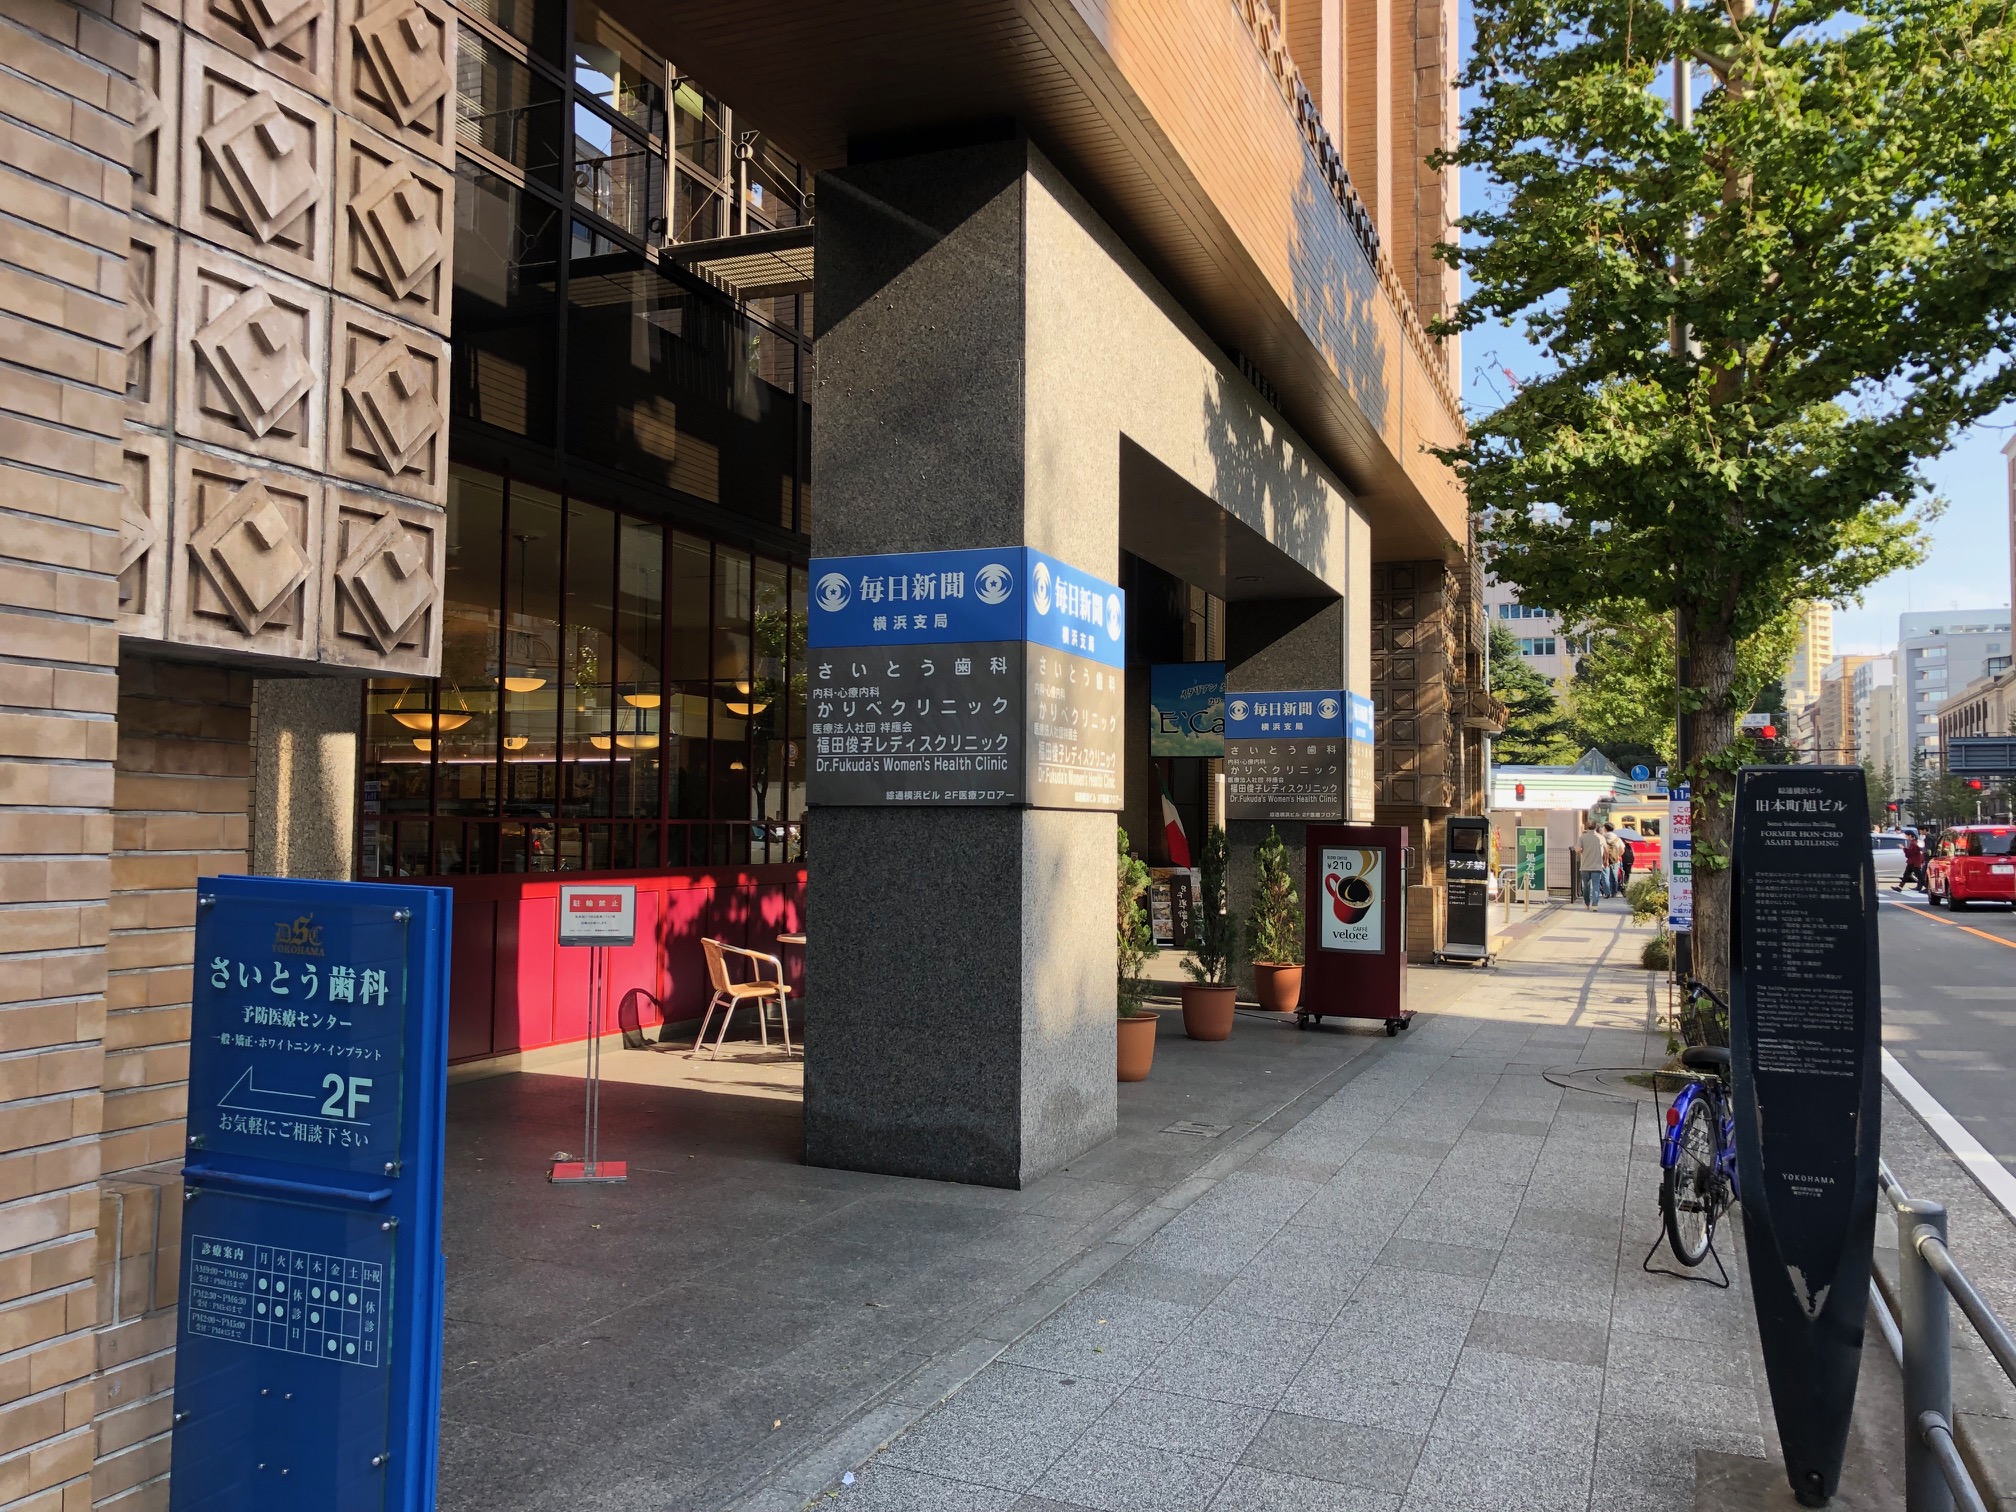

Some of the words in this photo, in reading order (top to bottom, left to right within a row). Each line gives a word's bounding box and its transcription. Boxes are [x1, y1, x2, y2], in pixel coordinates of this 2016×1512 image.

[860, 572, 964, 603] 毎日新聞
[1055, 576, 1103, 627] 毎日新聞
[873, 613, 948, 632] 横浜支局
[818, 656, 1008, 680] さいとう歯科
[818, 697, 1008, 718] かりべクリニック
[1254, 702, 1312, 716] 毎日新聞
[812, 722, 876, 734] 医療法人社団
[1261, 722, 1304, 731] 横浜支局
[816, 734, 1008, 754] 福田俊子レディスクリニック
[1230, 745, 1336, 754] さいとう歯科
[816, 758, 879, 772] Dr.Fukuda's
[884, 756, 930, 771] Women's
[934, 756, 972, 770] Health
[976, 756, 1008, 770] Clinic
[944, 790, 1014, 800] 2F医療フロアー
[1268, 794, 1295, 802] Women's
[1296, 794, 1318, 802] Health
[1318, 794, 1338, 802] Clinic
[1756, 798, 1848, 812] 旧本町旭ビル
[1760, 830, 1797, 838] FORMER
[1327, 861, 1352, 870] ¥210
[1332, 929, 1369, 940] veloce
[272, 944, 326, 956] YOKOHAMA
[210, 956, 389, 1006] さいとう歯科
[242, 1006, 352, 1031] 予防医療センター
[321, 1073, 373, 1119] 2F
[219, 1112, 369, 1148] お気軽にご相談下さい
[1782, 1173, 1835, 1184] YOKOHAMA
[202, 1243, 244, 1261] 診療案内
[260, 1252, 268, 1264] 月
[276, 1255, 286, 1267] 火
[294, 1258, 304, 1270] 水
[312, 1261, 322, 1273] 木
[330, 1264, 340, 1276] 金
[348, 1267, 358, 1279] 土
[292, 1289, 303, 1339] 休診日
[364, 1300, 376, 1352] 休診日
